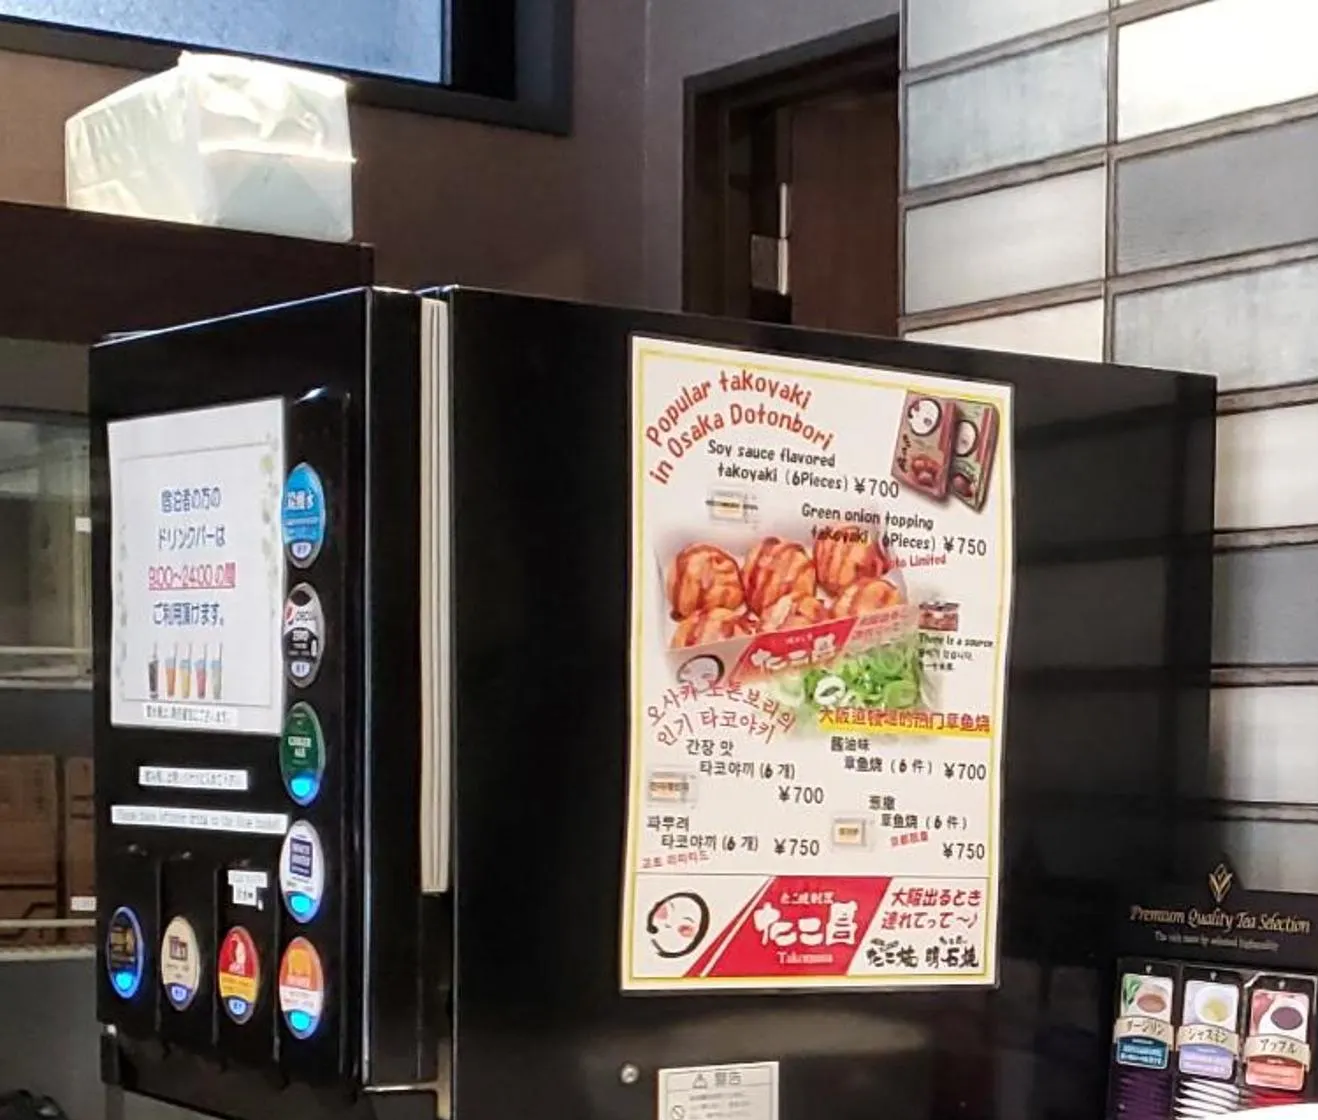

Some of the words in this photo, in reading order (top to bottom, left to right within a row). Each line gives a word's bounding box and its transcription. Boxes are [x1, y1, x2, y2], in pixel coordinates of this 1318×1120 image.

[646, 380, 712, 447] Popular
[719, 369, 812, 410] takoyaki
[649, 460, 674, 485] in
[667, 412, 724, 458] Osaka
[730, 403, 835, 451] Dotonbori
[708, 439, 732, 458] Soy
[737, 445, 775, 462] sauce
[780, 446, 836, 467] flavored
[718, 463, 778, 483] takoyaki
[854, 477, 899, 498] ¥700
[801, 503, 841, 521] Green
[844, 508, 881, 525] onion
[885, 511, 934, 532] topping
[159, 525, 226, 551] ドリンクバーは
[943, 536, 987, 557] ¥750
[909, 554, 947, 567] Limited
[647, 681, 698, 727] 오사카
[703, 679, 797, 733] 도톤보리의
[657, 713, 693, 746] 인기
[700, 707, 776, 744] 타코야키
[686, 739, 716, 757] 간장
[720, 739, 735, 757] 맛
[844, 756, 883, 773] 章鱼烧
[943, 762, 987, 781] ¥700
[777, 785, 825, 805] ¥700
[880, 813, 919, 829] 章鱼烧
[773, 838, 821, 857] ¥750
[942, 843, 986, 861] ¥750
[753, 901, 859, 947] たこ昌
[1129, 905, 1185, 925] Premium
[1187, 908, 1233, 932] Quality
[1236, 911, 1257, 929] Tea
[1258, 913, 1311, 935] Selection
[1260, 1039, 1297, 1054] アップル
